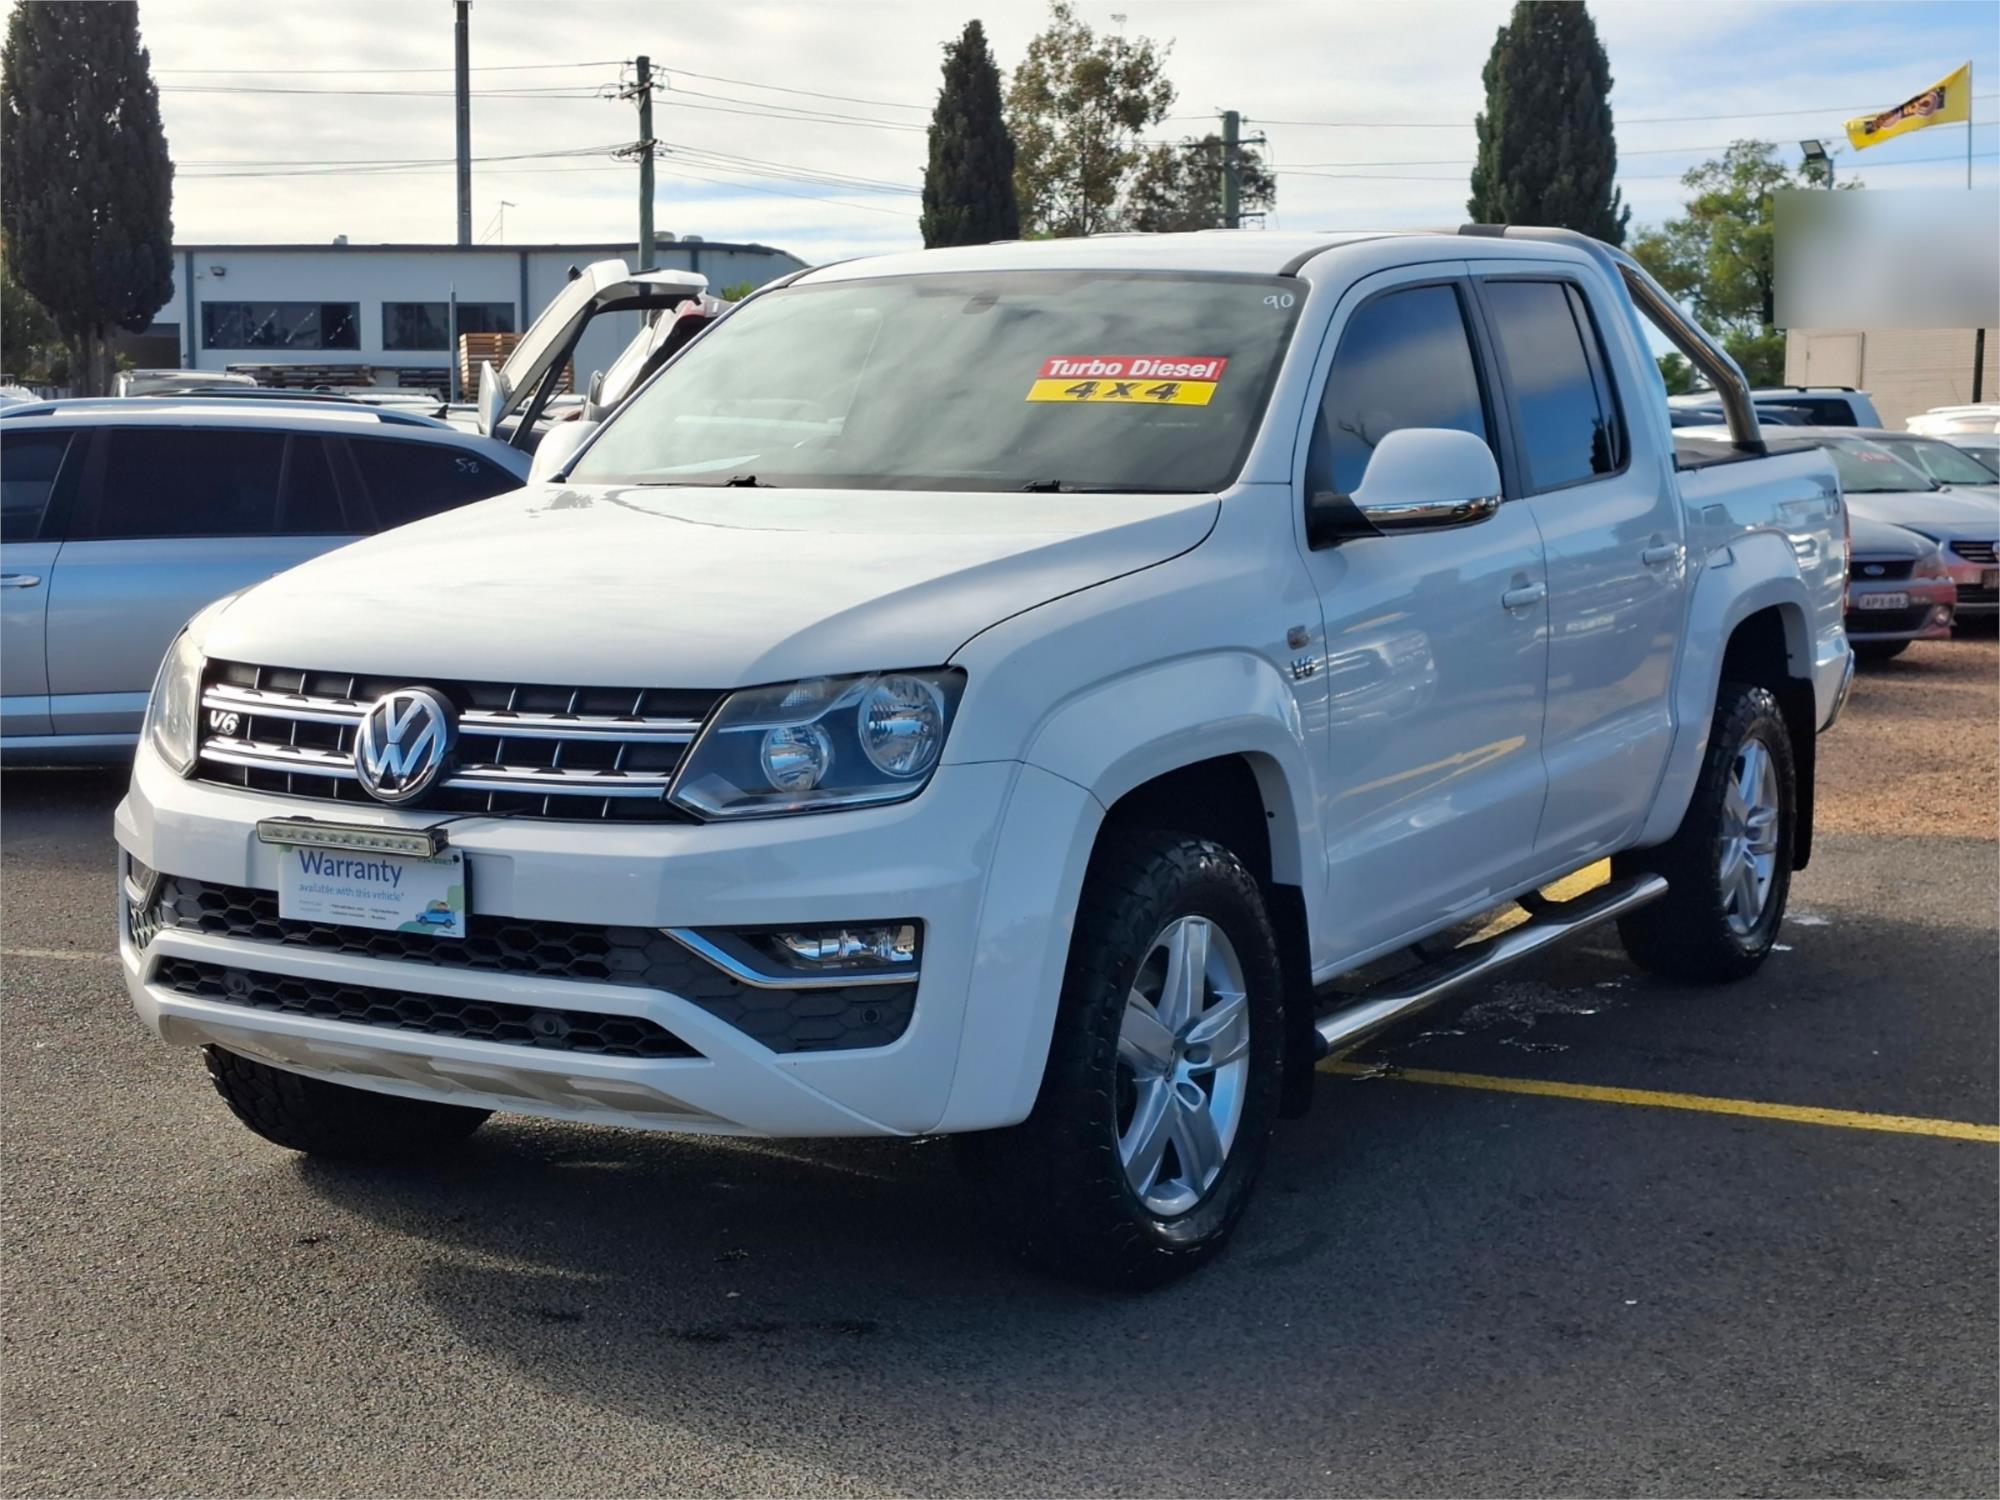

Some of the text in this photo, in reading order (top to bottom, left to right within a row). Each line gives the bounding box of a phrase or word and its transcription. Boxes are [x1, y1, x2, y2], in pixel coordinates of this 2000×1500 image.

[1049, 359, 1218, 378] Turbo Diesel
[210, 709, 240, 736] V6
[299, 850, 403, 888] Warranty
[335, 886, 354, 898] with
[355, 888, 371, 899] this
